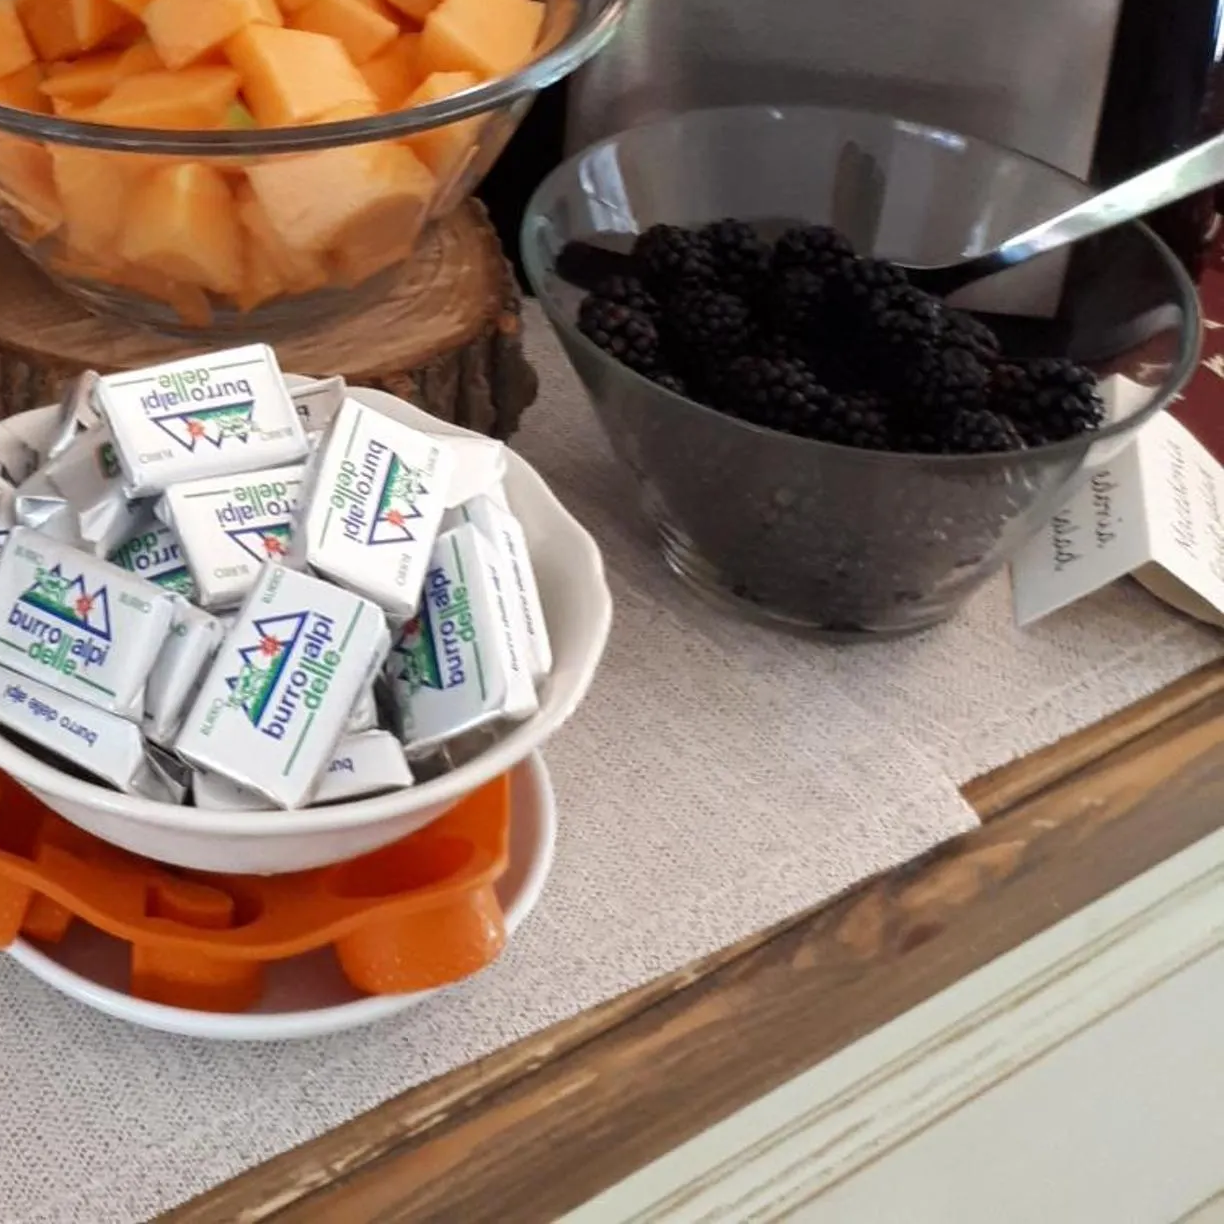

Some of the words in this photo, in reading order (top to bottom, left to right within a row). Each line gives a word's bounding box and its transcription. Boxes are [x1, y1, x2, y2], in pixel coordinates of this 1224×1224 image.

[139, 388, 178, 416] alpi
[158, 367, 210, 405] delle
[191, 378, 254, 403] burro
[331, 460, 368, 510] delle
[356, 438, 389, 497] burro
[214, 499, 255, 528] alpi
[234, 480, 288, 520] delle
[340, 498, 367, 545] alpi
[429, 566, 454, 610] alpi
[7, 602, 63, 645] burro
[303, 611, 337, 660] alpi
[437, 586, 476, 643] delle
[27, 634, 78, 676] delle
[70, 637, 111, 668] alpi
[439, 619, 467, 690] burro
[298, 648, 342, 711] delle
[260, 670, 309, 741] burro
